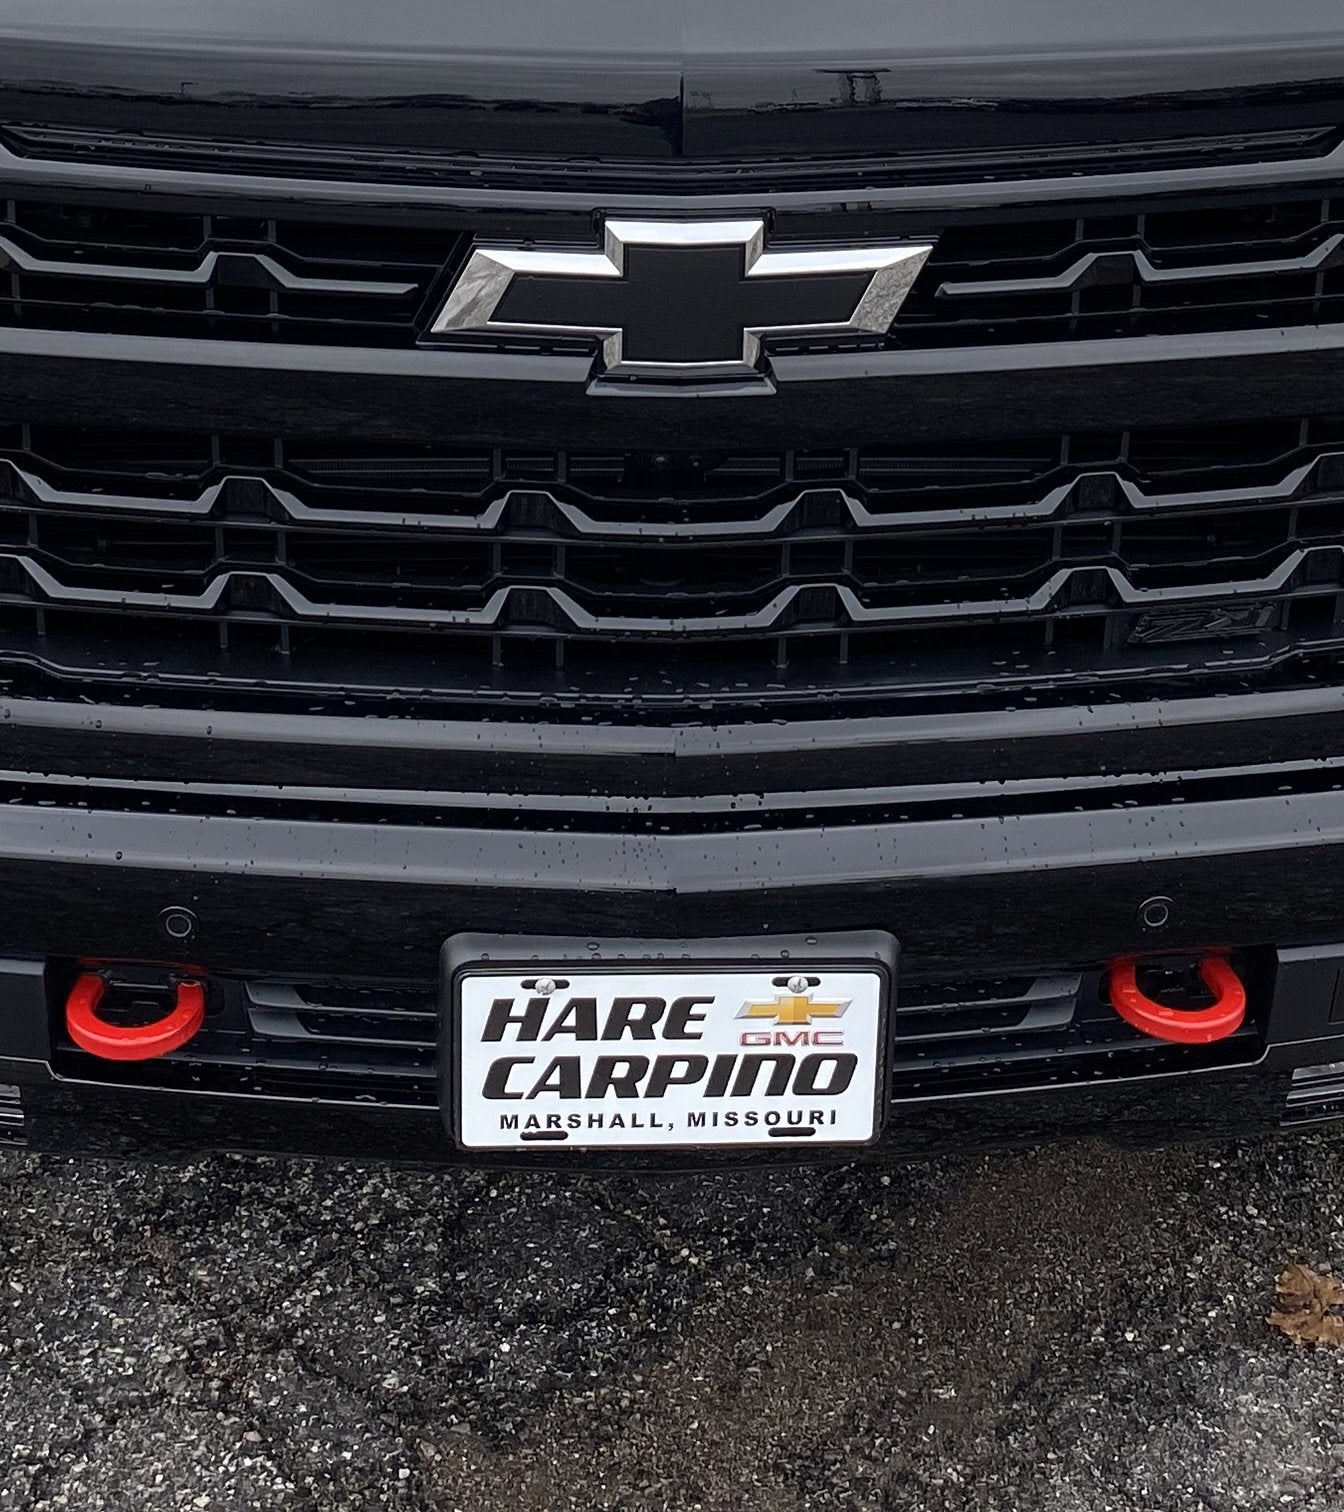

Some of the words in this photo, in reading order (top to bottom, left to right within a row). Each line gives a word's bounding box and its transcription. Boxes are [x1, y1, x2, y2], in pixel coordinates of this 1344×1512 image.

[479, 995, 716, 1043] HARE
[738, 1030, 845, 1048] GMC
[480, 1052, 859, 1101] CARPINO
[499, 1111, 676, 1132] MARSHALL,
[686, 1108, 839, 1128] MISSOURI
